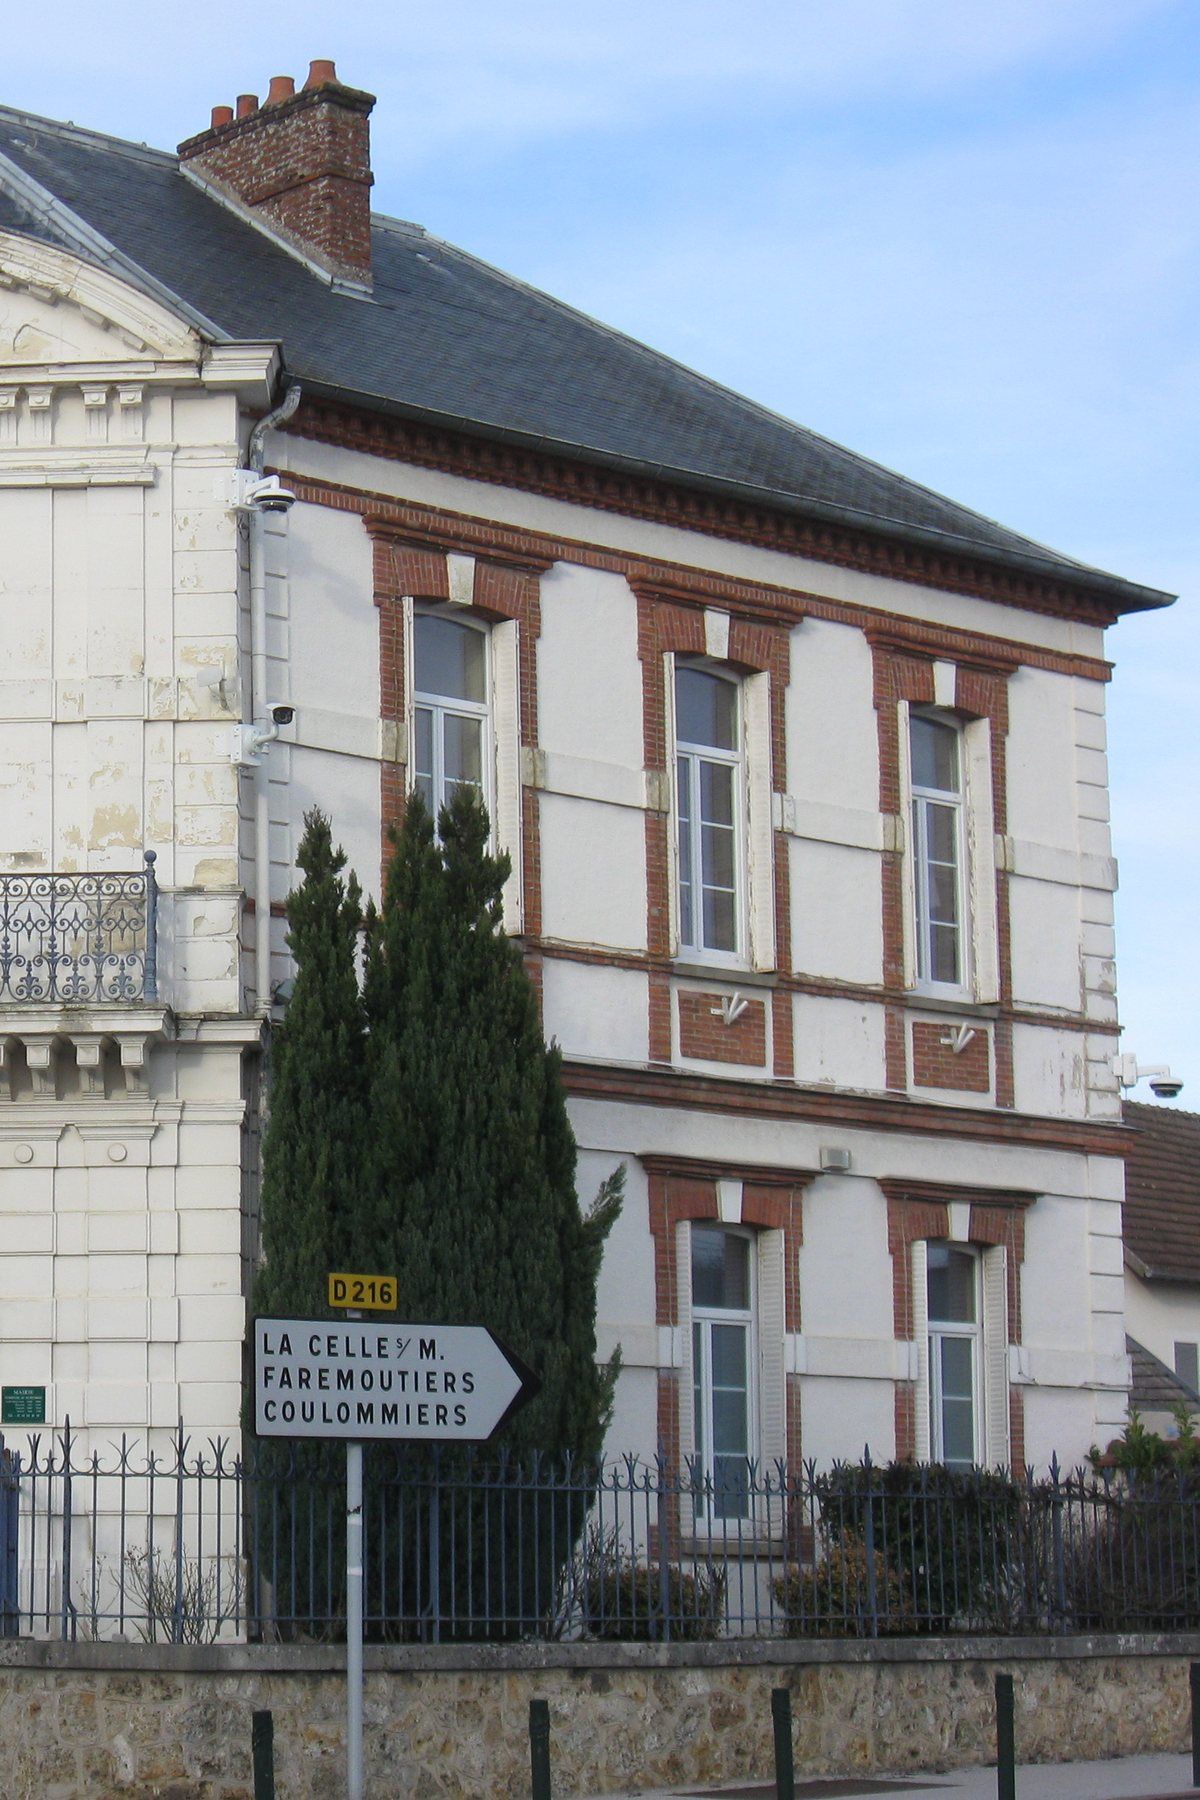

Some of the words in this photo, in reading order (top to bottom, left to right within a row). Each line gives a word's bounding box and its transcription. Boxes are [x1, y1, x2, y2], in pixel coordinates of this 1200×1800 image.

[263, 1333, 293, 1356] LA
[309, 1335, 389, 1359] CELLE
[263, 1366, 475, 1394] FAREMOUTIERS
[264, 1399, 468, 1427] COULOMMIERS
